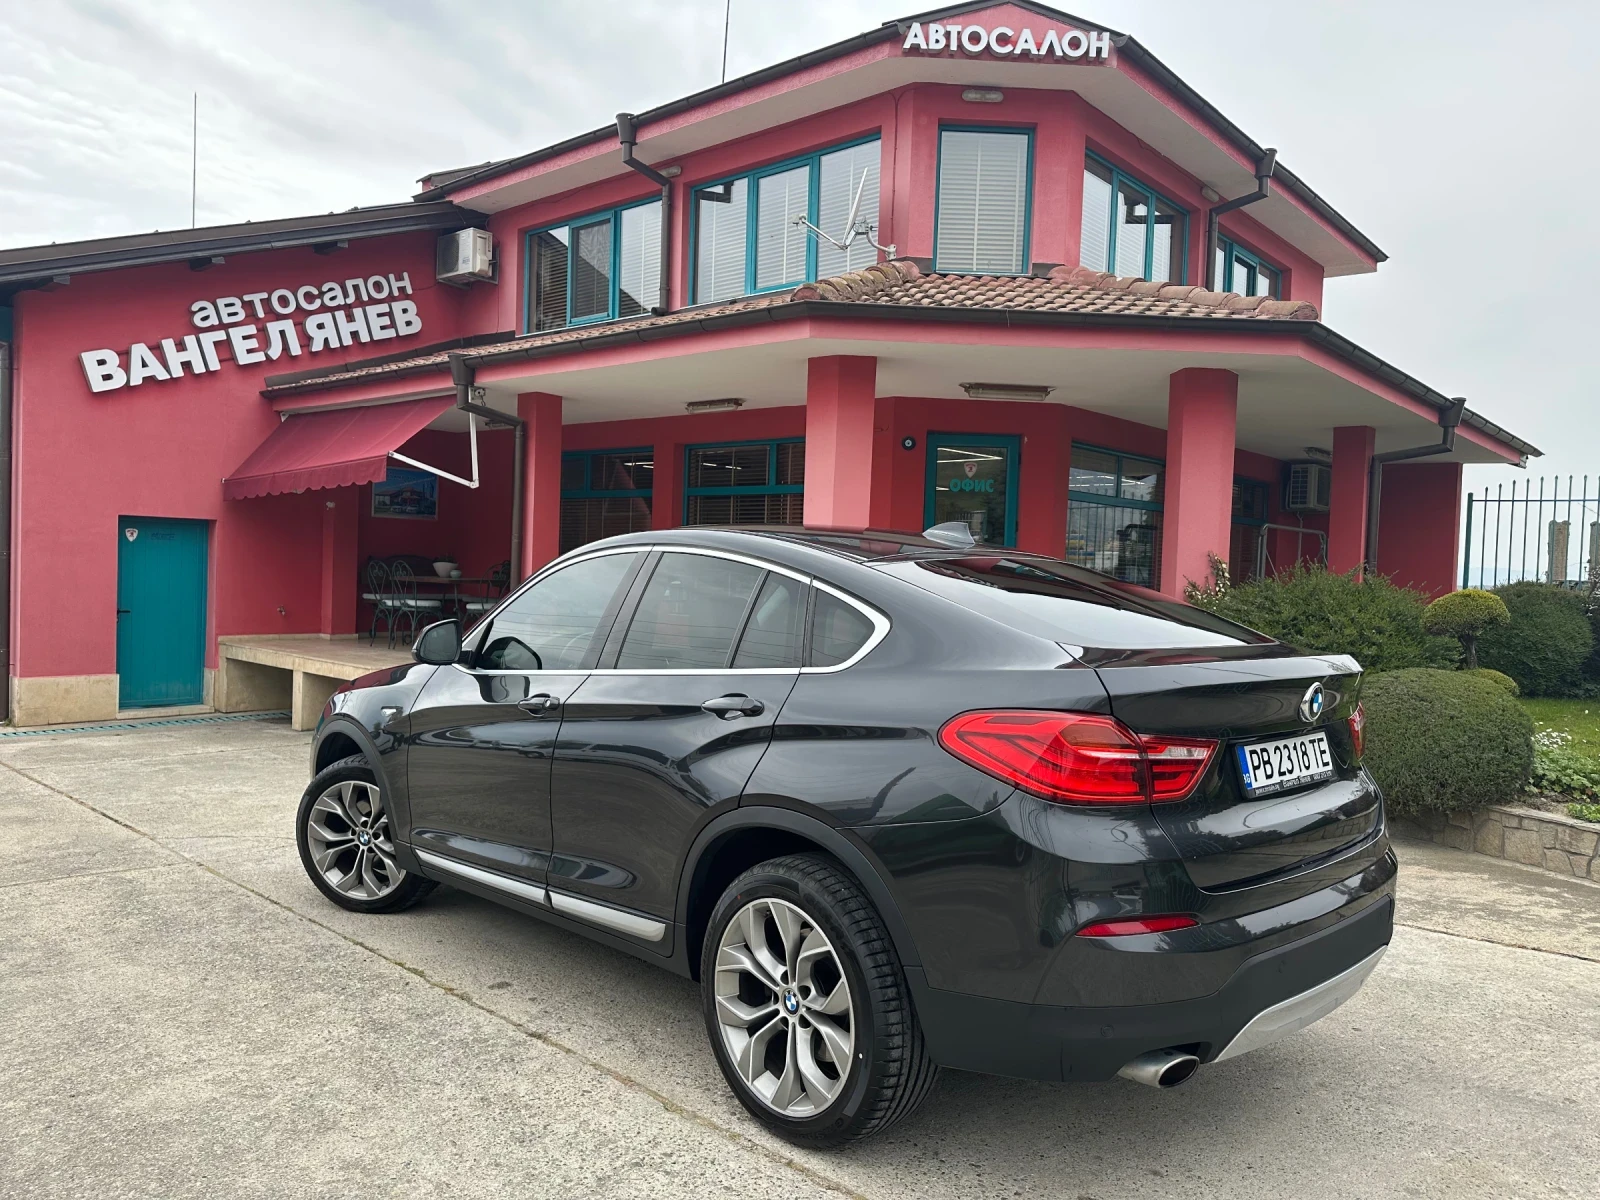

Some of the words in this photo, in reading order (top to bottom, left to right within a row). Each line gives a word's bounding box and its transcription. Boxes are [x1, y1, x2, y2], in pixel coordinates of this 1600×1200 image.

[903, 22, 1110, 60] АВТОСАЛОН
[190, 271, 413, 328] автосалон
[80, 318, 302, 393] ВАНГЕЛ
[304, 299, 423, 353] ЯНЕВ
[950, 478, 995, 493] ОФИС
